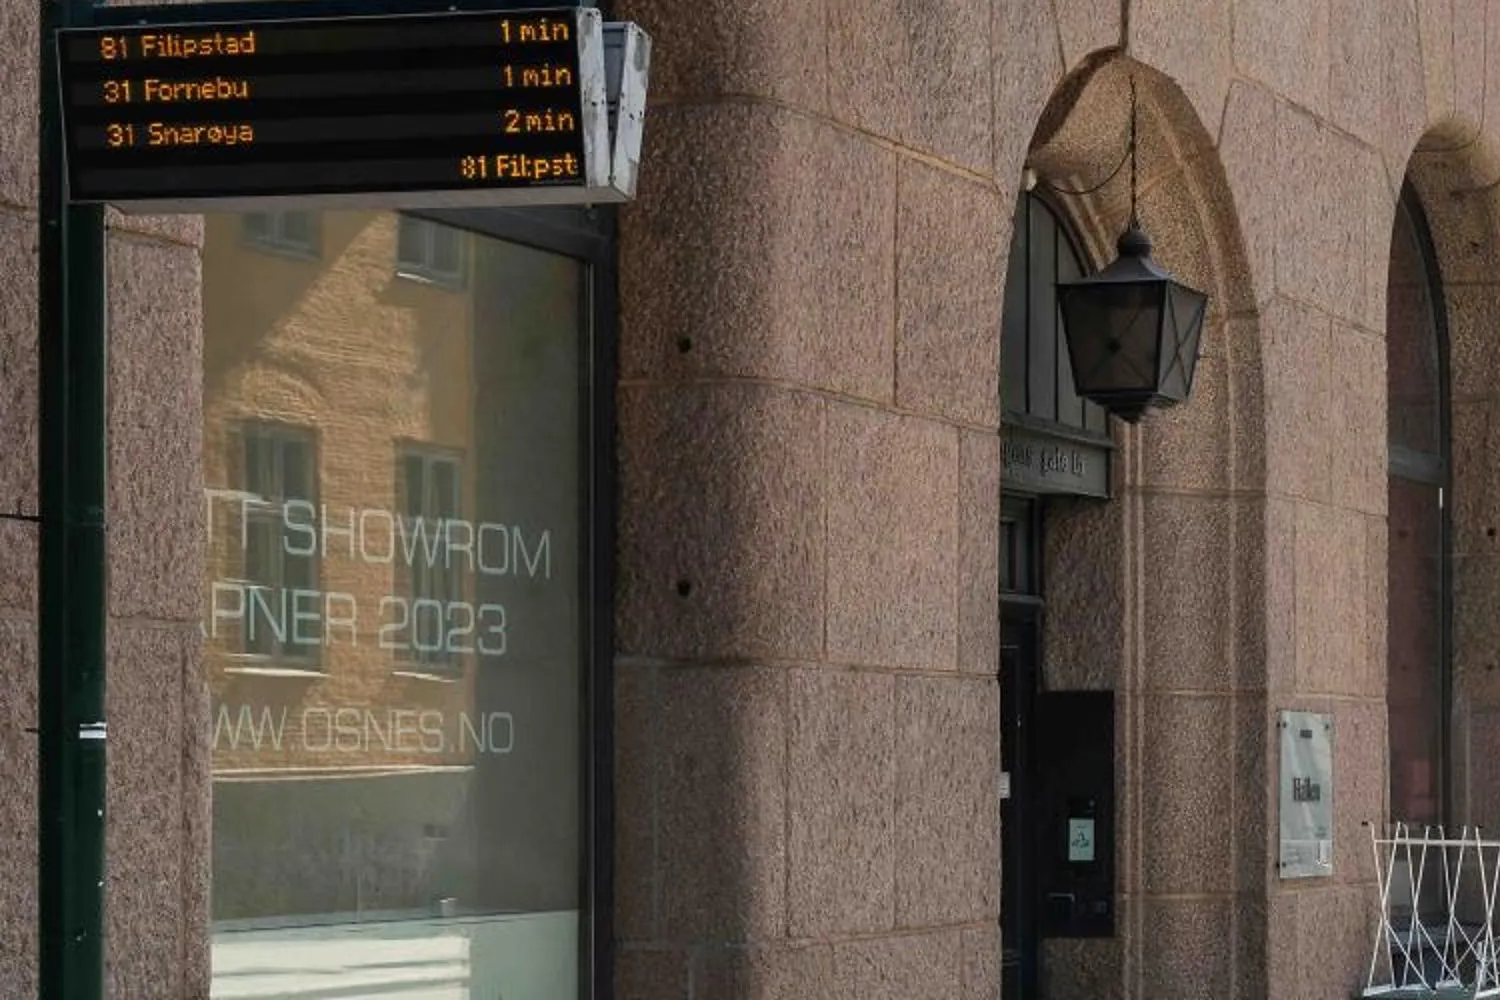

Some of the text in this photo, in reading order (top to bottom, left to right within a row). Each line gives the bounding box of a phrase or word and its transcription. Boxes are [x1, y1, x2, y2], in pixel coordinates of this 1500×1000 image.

[101, 18, 569, 60] 81 Filipstad 1 min
[104, 64, 570, 103] 31 Fornebu 1 min
[108, 108, 574, 147] 31 Snarøya 2 min
[283, 499, 551, 580] SHOWROM
[200, 581, 507, 656] PNER 2023
